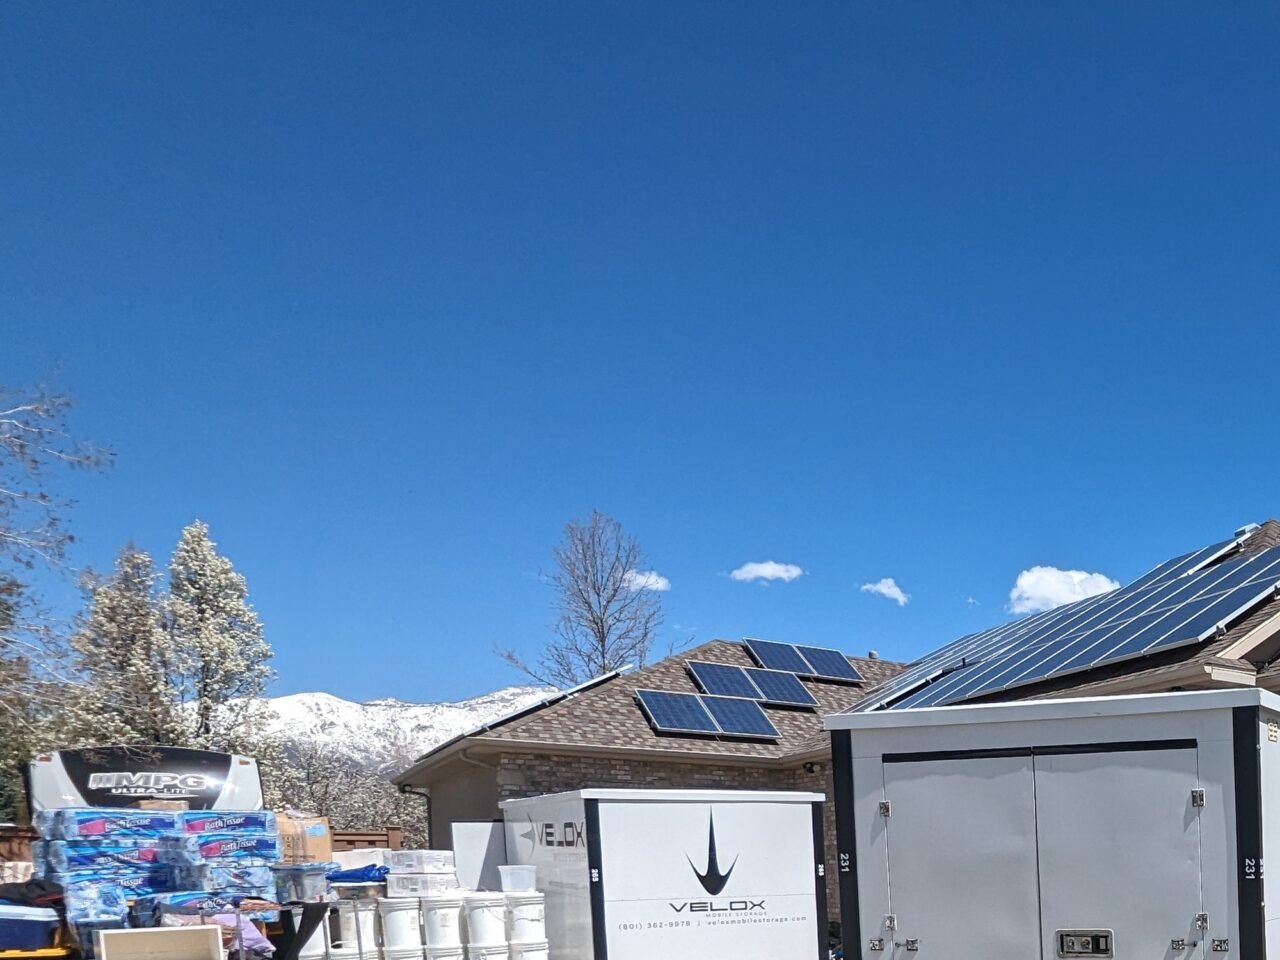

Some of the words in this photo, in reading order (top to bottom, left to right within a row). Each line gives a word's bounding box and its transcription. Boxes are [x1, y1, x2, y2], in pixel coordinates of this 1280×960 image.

[114, 772, 207, 790] MPG
[204, 819, 224, 832] Bath
[223, 816, 246, 828] Tissue
[236, 838, 257, 849] Tissue
[535, 822, 586, 848] VELOX
[840, 853, 850, 872] 231
[1245, 858, 1256, 879] 231
[669, 900, 766, 913] VELOX
[618, 922, 643, 931] (801)
[647, 920, 691, 929] 362-9978
